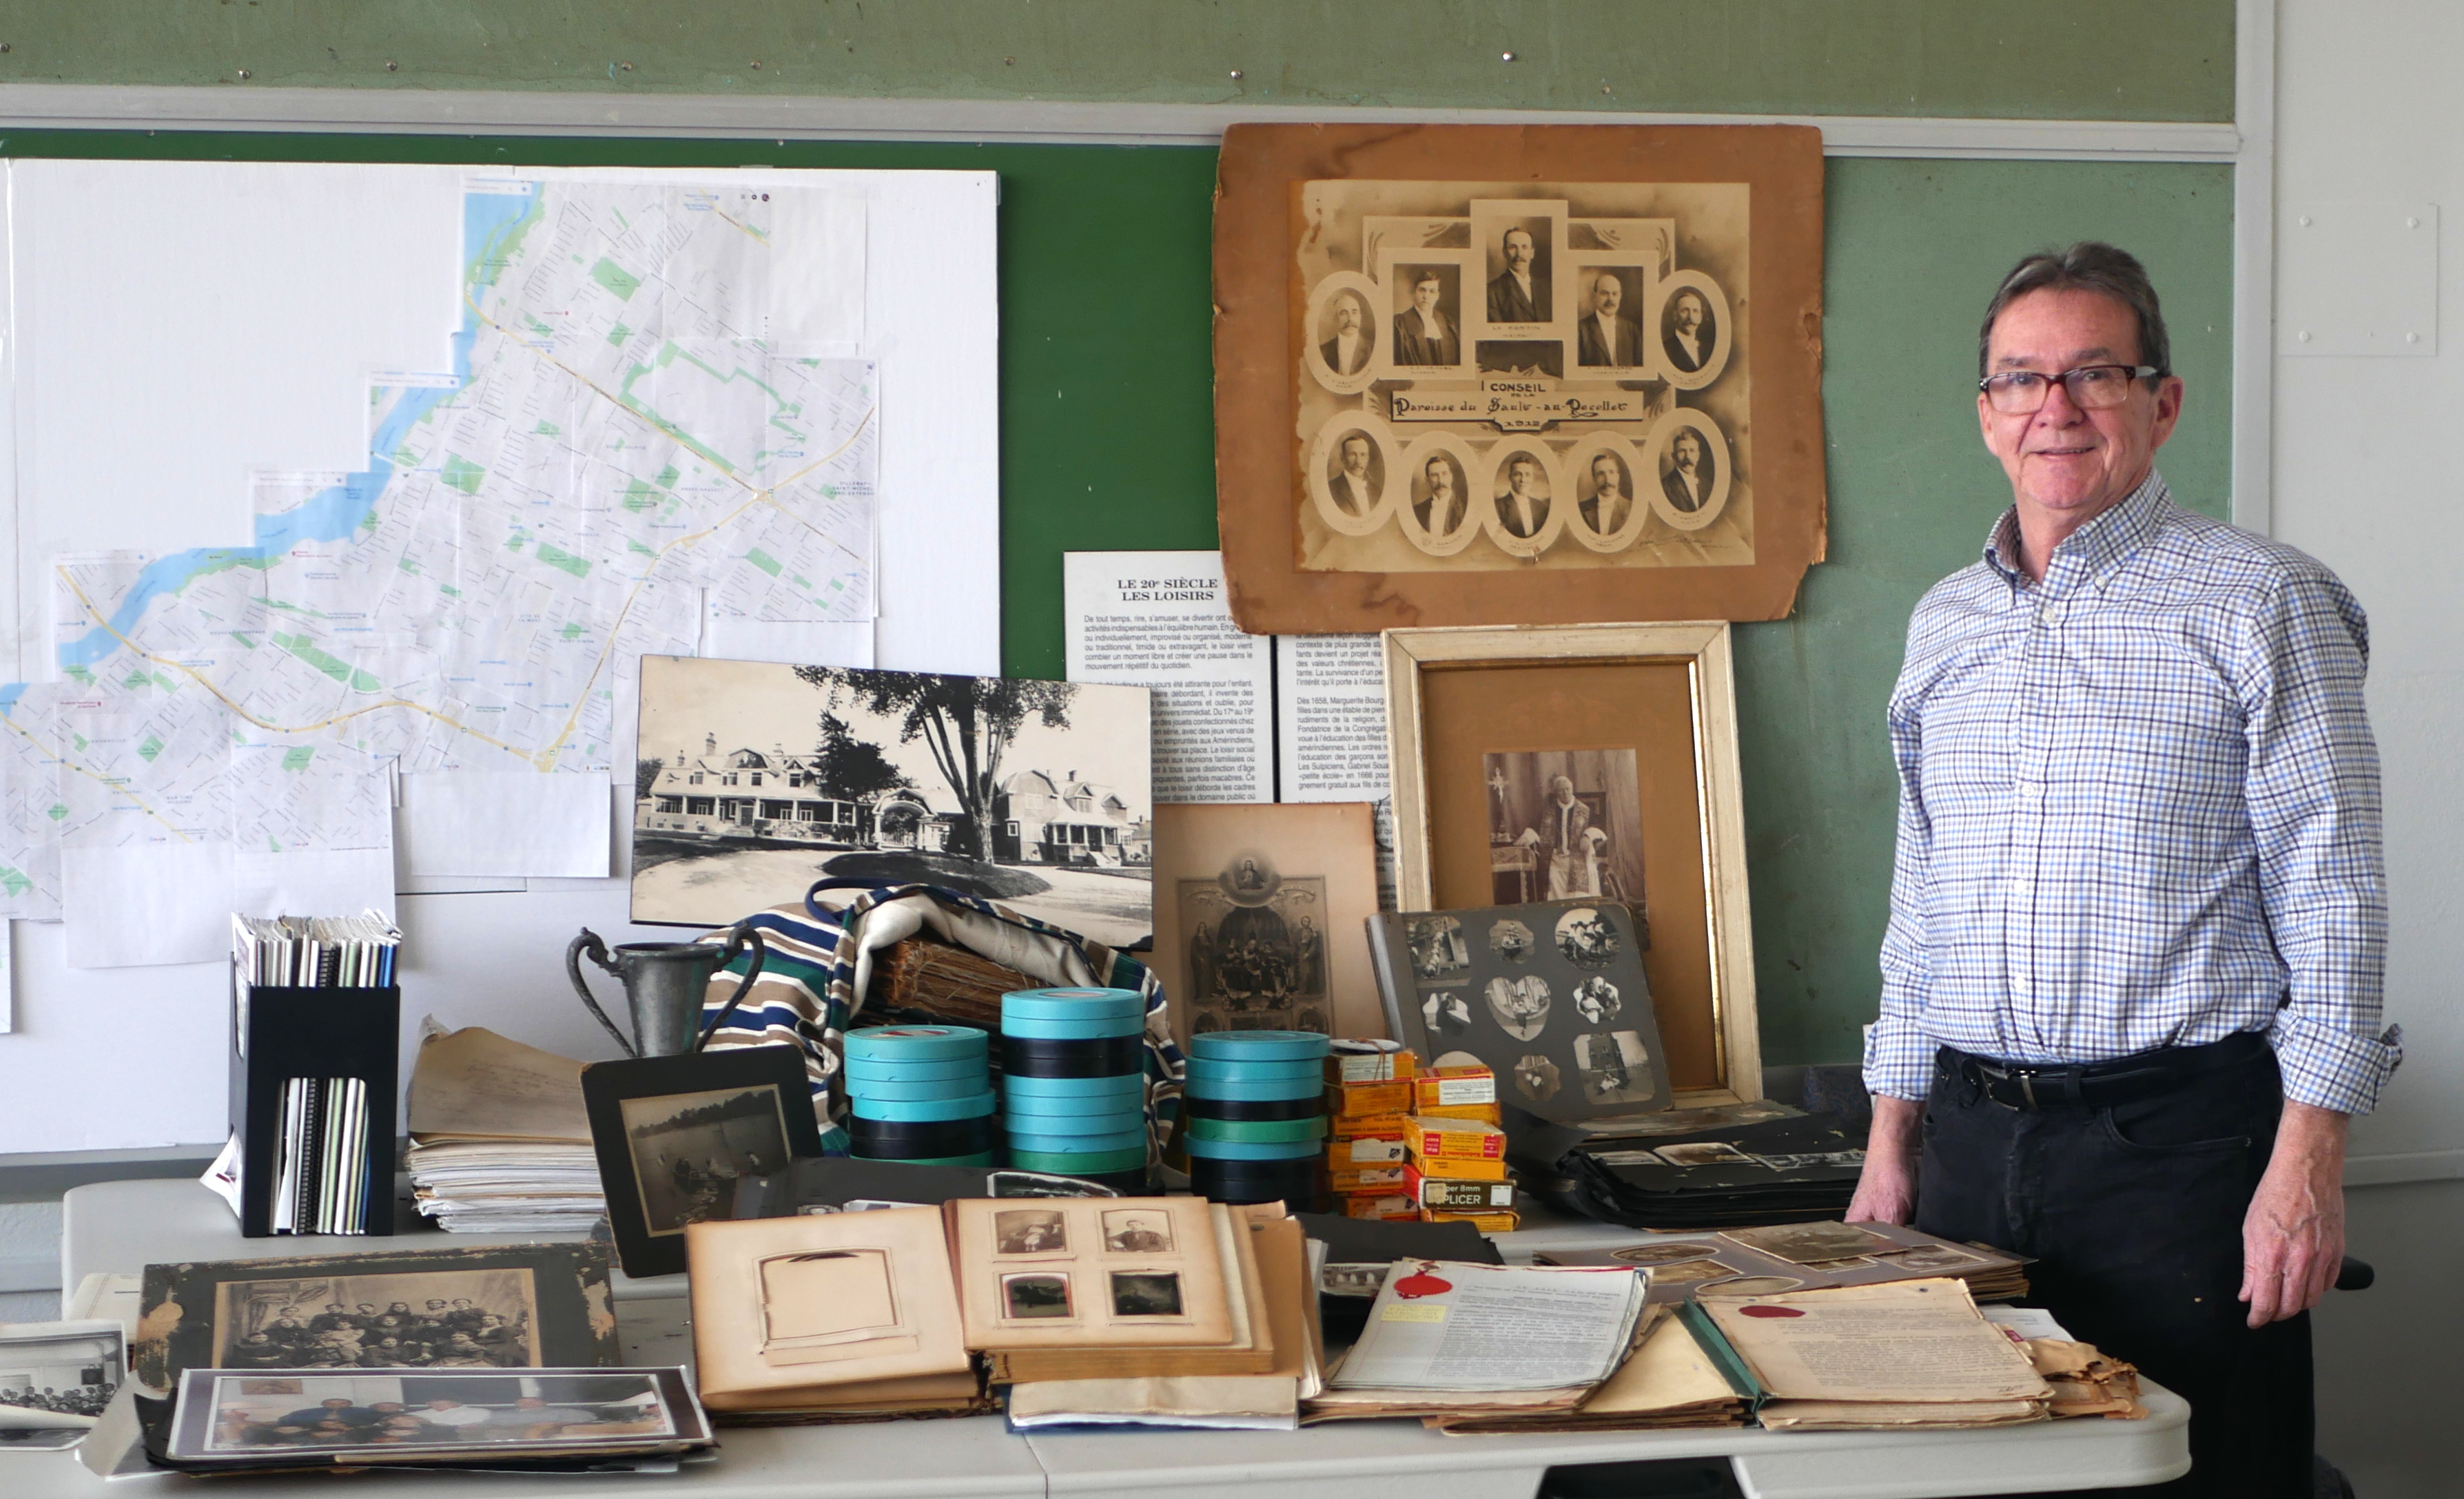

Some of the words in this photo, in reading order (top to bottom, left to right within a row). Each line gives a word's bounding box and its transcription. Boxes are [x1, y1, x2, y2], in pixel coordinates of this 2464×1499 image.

[1490, 383, 1546, 392] CONSEIL
[1460, 401, 1476, 411] du
[1118, 579, 1136, 589] LE
[1164, 577, 1218, 588] SIÈCLE
[1122, 592, 1150, 601] LES
[1155, 592, 1213, 601] LOISIRS
[1164, 624, 1193, 632] l'équilibre
[1151, 633, 1180, 642] improvisé
[1193, 633, 1222, 642] organisé,
[1335, 641, 1348, 649] plus
[1349, 641, 1371, 650] grande
[1351, 650, 1368, 659] projet
[1125, 662, 1149, 670] répétitif
[1160, 662, 1191, 670] quotidien.
[1146, 681, 1171, 690] toujours
[1322, 679, 1334, 687] qu'il
[1359, 678, 1383, 686] l'éducat
[1331, 697, 1364, 706] Marguerite
[1365, 696, 1384, 706] Bourg
[1342, 705, 1361, 714] étable
[1173, 719, 1192, 727] jouets
[1353, 716, 1377, 724] religion,
[1353, 725, 1386, 734] Congrégat
[1164, 737, 1198, 745] empruntés
[1190, 747, 1209, 755] place.
[1348, 754, 1374, 762] garçons
[1237, 765, 1255, 773] d'âge
[1312, 763, 1345, 771] Sulpiciens,
[1153, 775, 1186, 783] piquantes,
[1299, 782, 1326, 791] gnement
[1328, 782, 1347, 790] gratuit
[1226, 793, 1246, 801] public
[1445, 1185, 1458, 1193] per
[1444, 1195, 1481, 1204] PLICER
